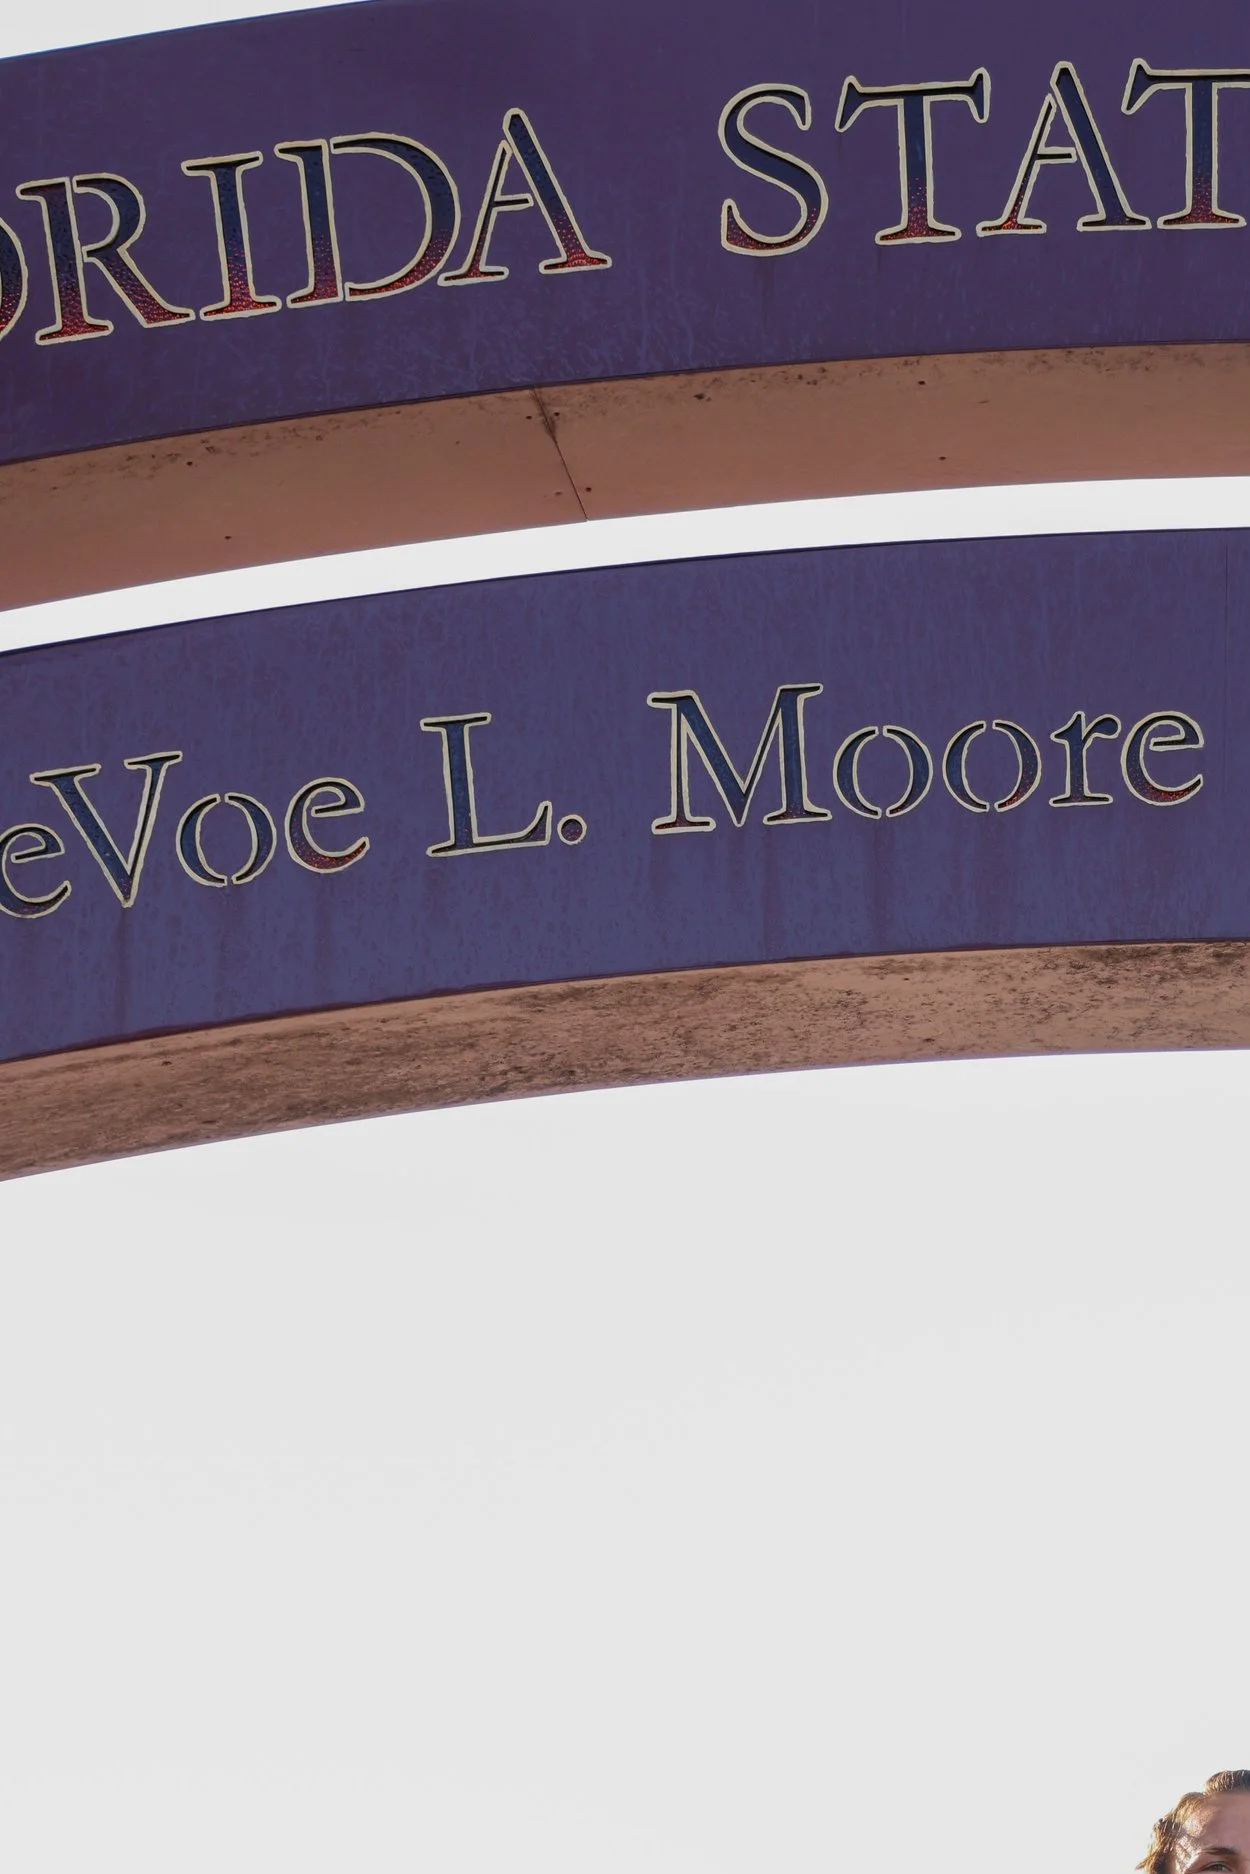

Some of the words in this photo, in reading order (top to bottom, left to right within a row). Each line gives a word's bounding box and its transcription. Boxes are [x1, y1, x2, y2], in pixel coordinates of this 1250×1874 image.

[0, 108, 612, 345] RIDA
[0, 750, 370, 919] eVoe
[419, 712, 588, 858] L.
[646, 682, 1204, 835] Moore
